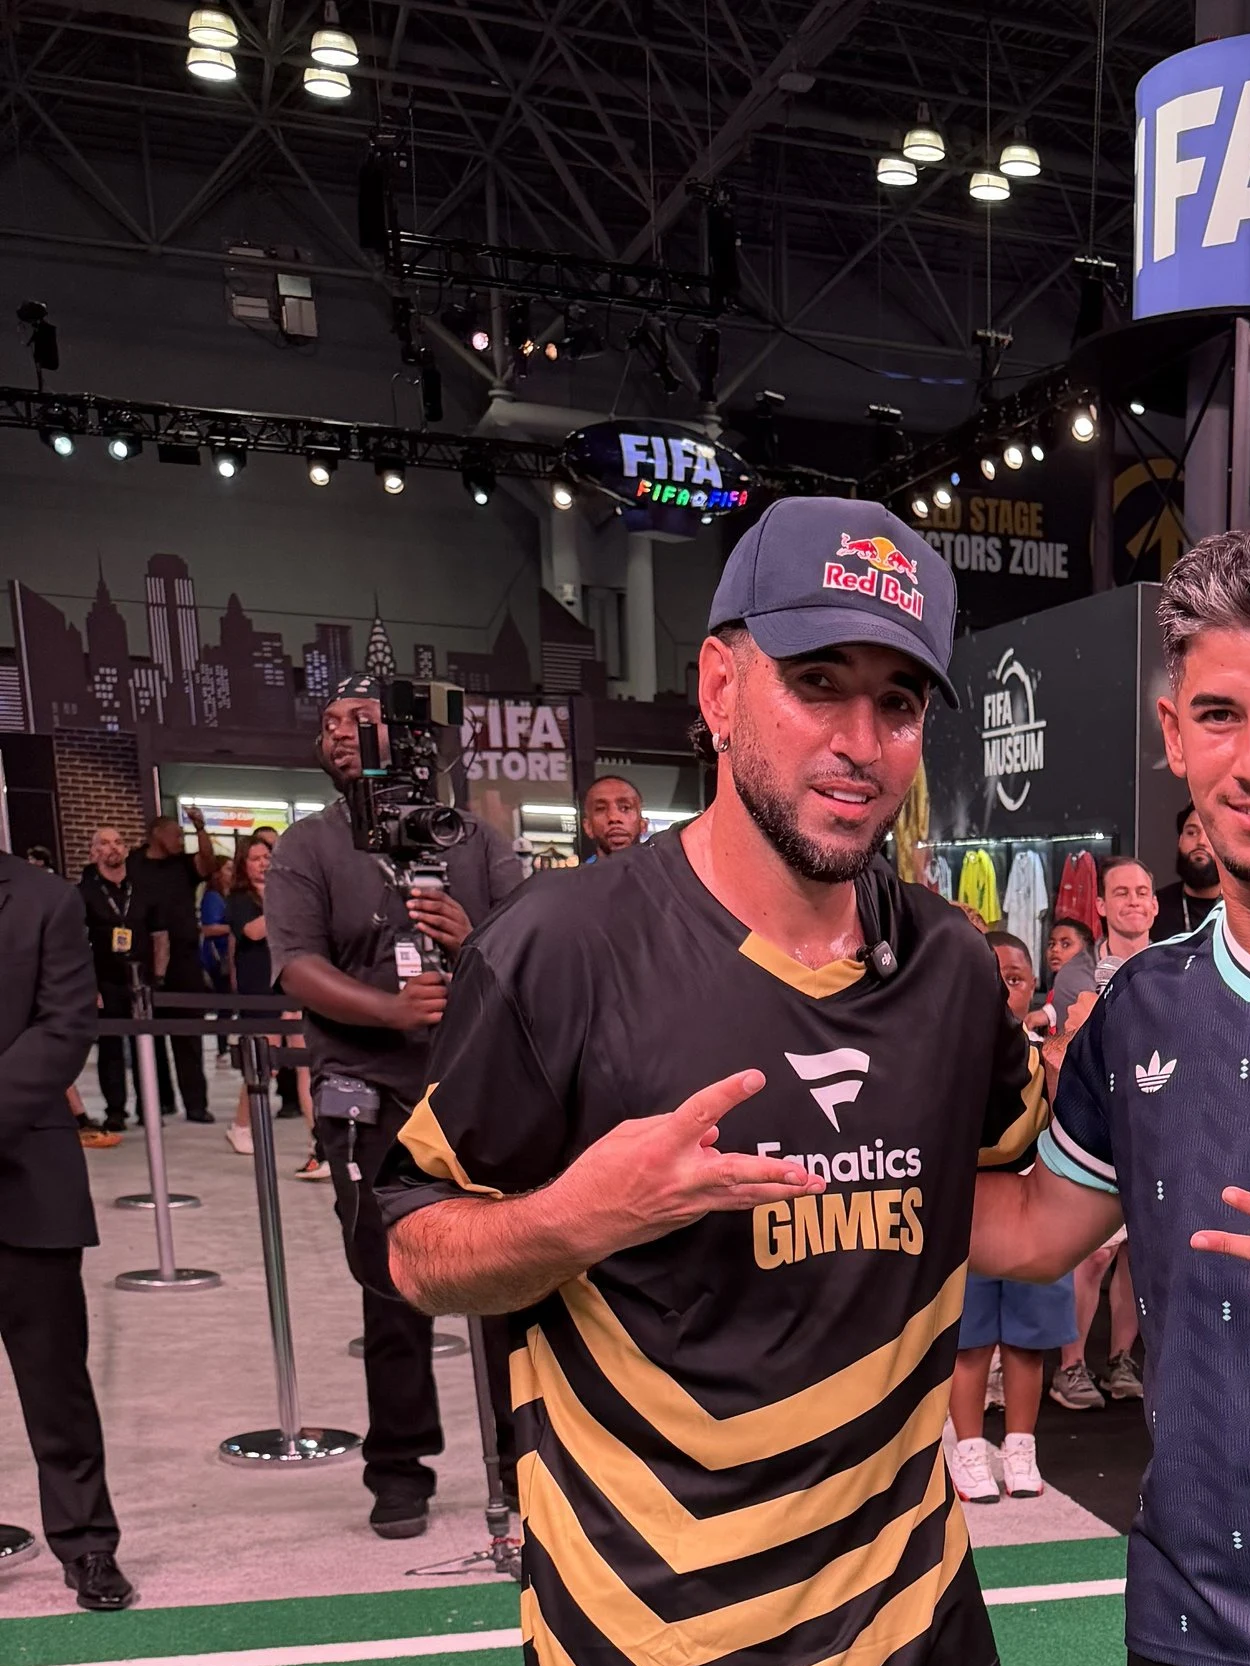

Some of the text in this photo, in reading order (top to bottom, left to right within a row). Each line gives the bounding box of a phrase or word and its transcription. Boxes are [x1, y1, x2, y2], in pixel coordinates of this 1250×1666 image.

[619, 433, 723, 488] FIFA
[636, 479, 690, 506] FIFA
[970, 496, 1044, 538] STAGE
[1009, 538, 1069, 579] ZONE
[823, 562, 924, 621] Red Bull
[984, 690, 1013, 729] FIFA
[463, 751, 568, 782] STORE
[984, 730, 1044, 777] MUSEUM
[752, 1186, 924, 1270] GAMES
